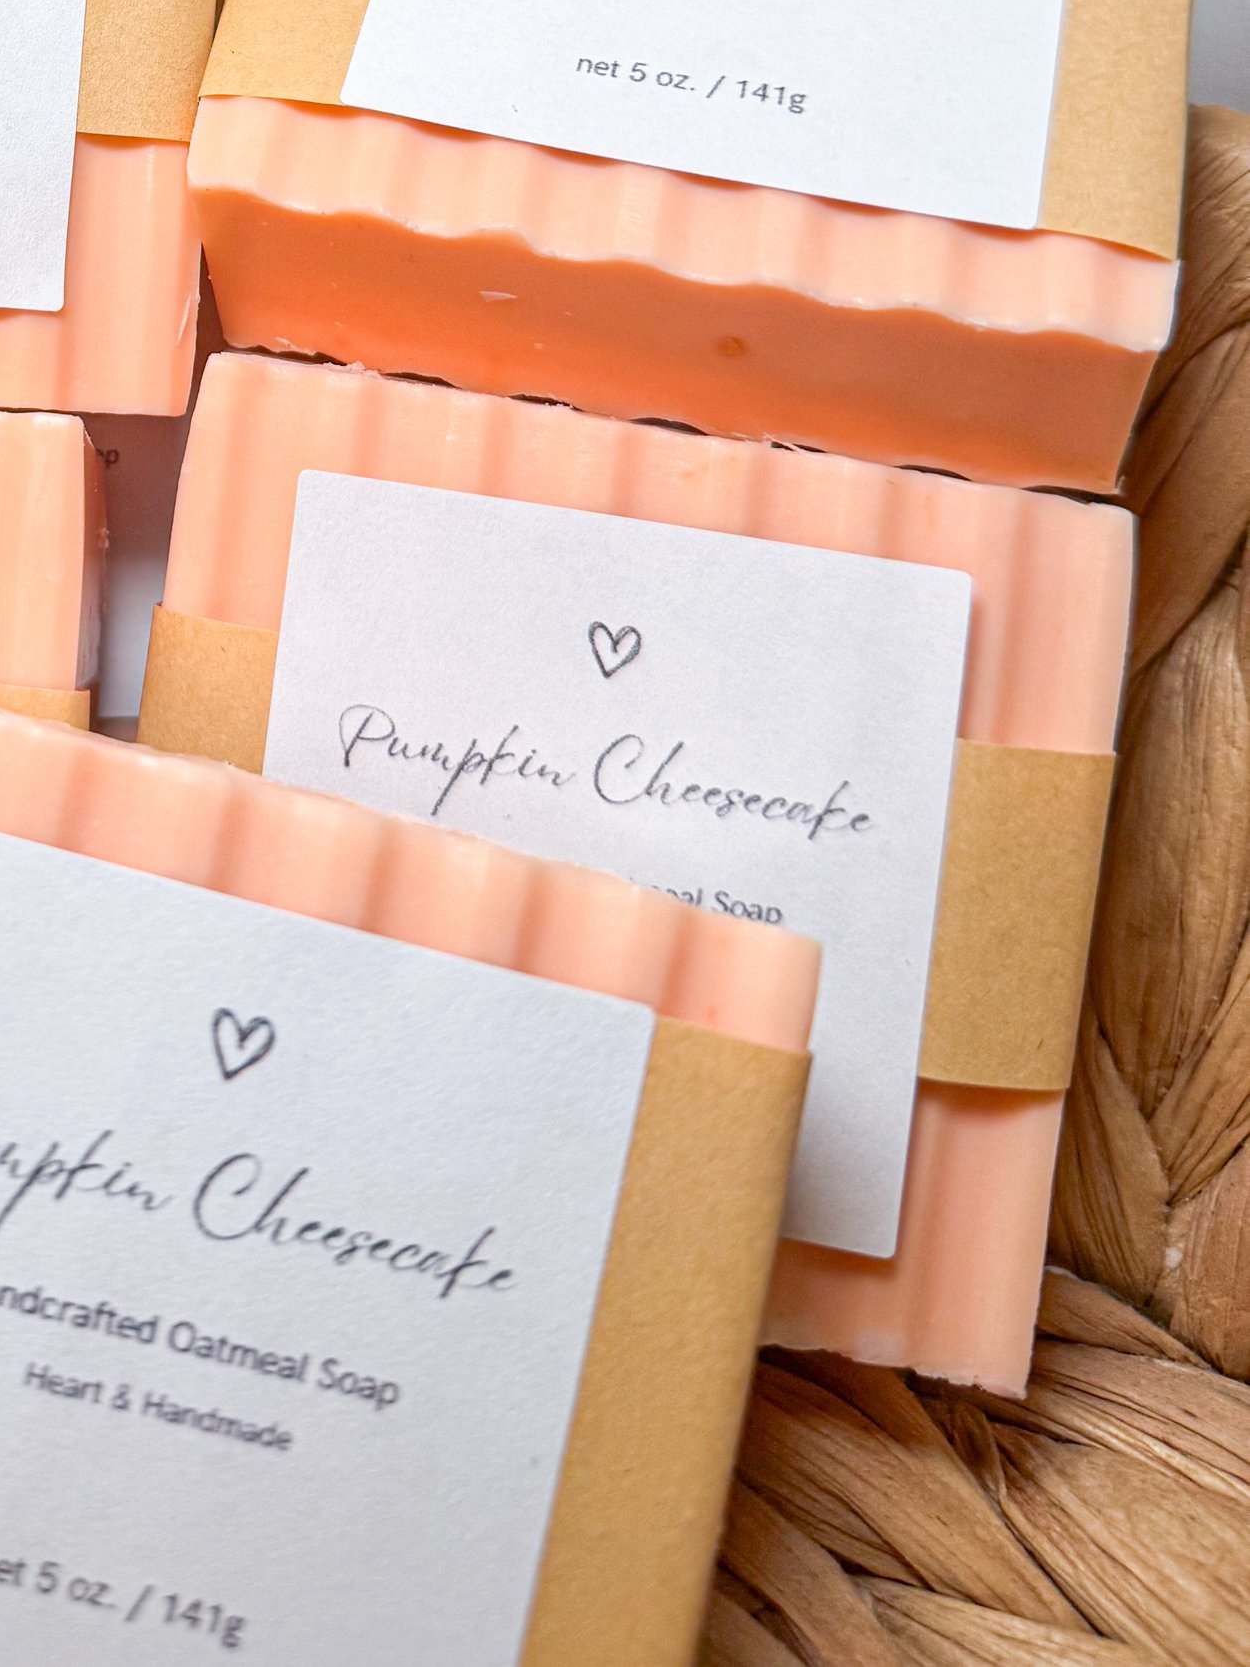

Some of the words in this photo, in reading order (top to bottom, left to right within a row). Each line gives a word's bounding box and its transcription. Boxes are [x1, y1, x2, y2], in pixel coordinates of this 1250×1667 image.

[576, 55, 620, 80] net
[629, 62, 648, 83] 5
[656, 68, 697, 92] oz.
[706, 75, 726, 99] /
[737, 80, 807, 115] 141g
[338, 704, 576, 816] Pumpkin
[592, 734, 874, 841] Cheesecake
[192, 1152, 519, 1300] Cheesecake
[23, 1363, 104, 1404] Heart
[111, 1384, 131, 1412] &
[142, 1392, 293, 1452] Handmade
[167, 1320, 310, 1383] Oatmeal
[317, 1357, 400, 1412] Soap
[35, 1561, 60, 1595] 5
[68, 1573, 118, 1611] oz.
[125, 1584, 153, 1622] /
[164, 1594, 246, 1651] 141g
